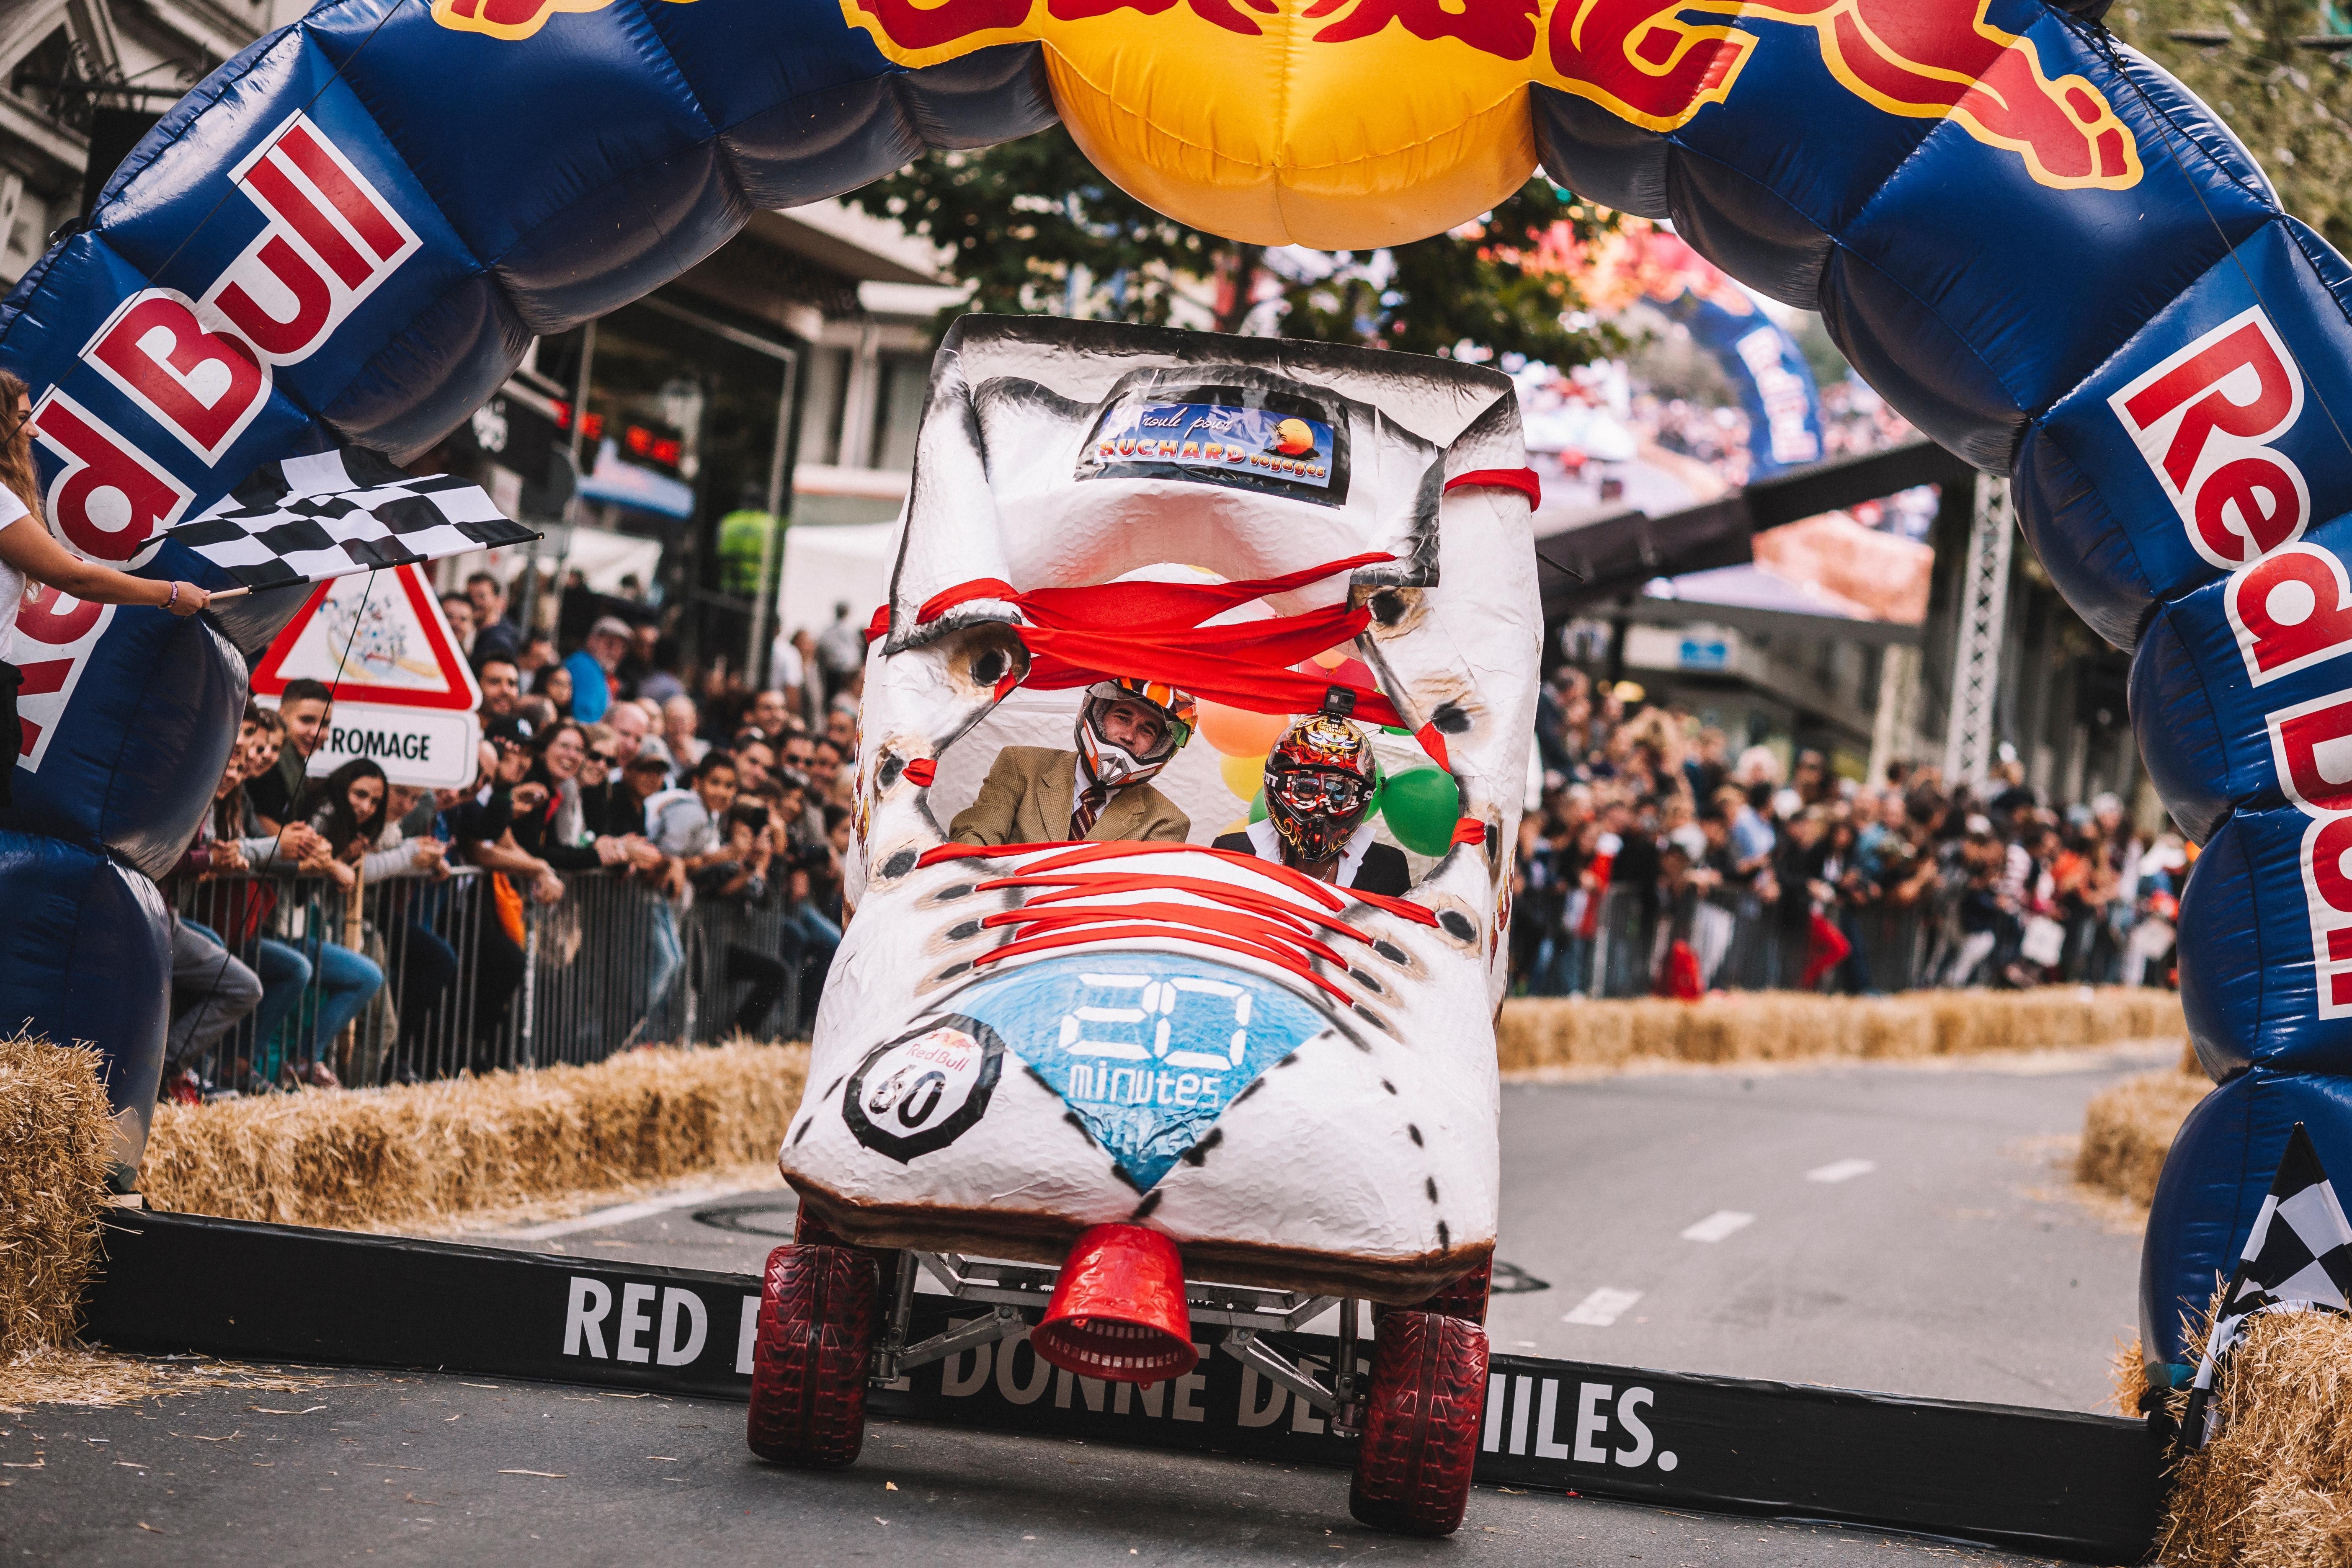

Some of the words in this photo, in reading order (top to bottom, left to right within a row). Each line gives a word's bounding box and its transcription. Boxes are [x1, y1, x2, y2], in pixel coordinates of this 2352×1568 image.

[91, 121, 409, 454] Bull
[1142, 407, 1188, 427] roule
[1184, 416, 1233, 438] pour
[1099, 438, 1246, 463] BUCHARD
[1249, 453, 1326, 478] voyages
[2122, 318, 2352, 675] Red
[322, 727, 430, 761] ROMAGE
[1058, 972, 1253, 1071] 20
[906, 1044, 940, 1060] Red
[935, 1051, 970, 1071] Bull
[1068, 1060, 1222, 1108] minutes
[869, 1064, 946, 1128] 60
[563, 1276, 708, 1366] RED
[1237, 1354, 1371, 1438] DE
[1483, 1373, 1678, 1471] IILES.
